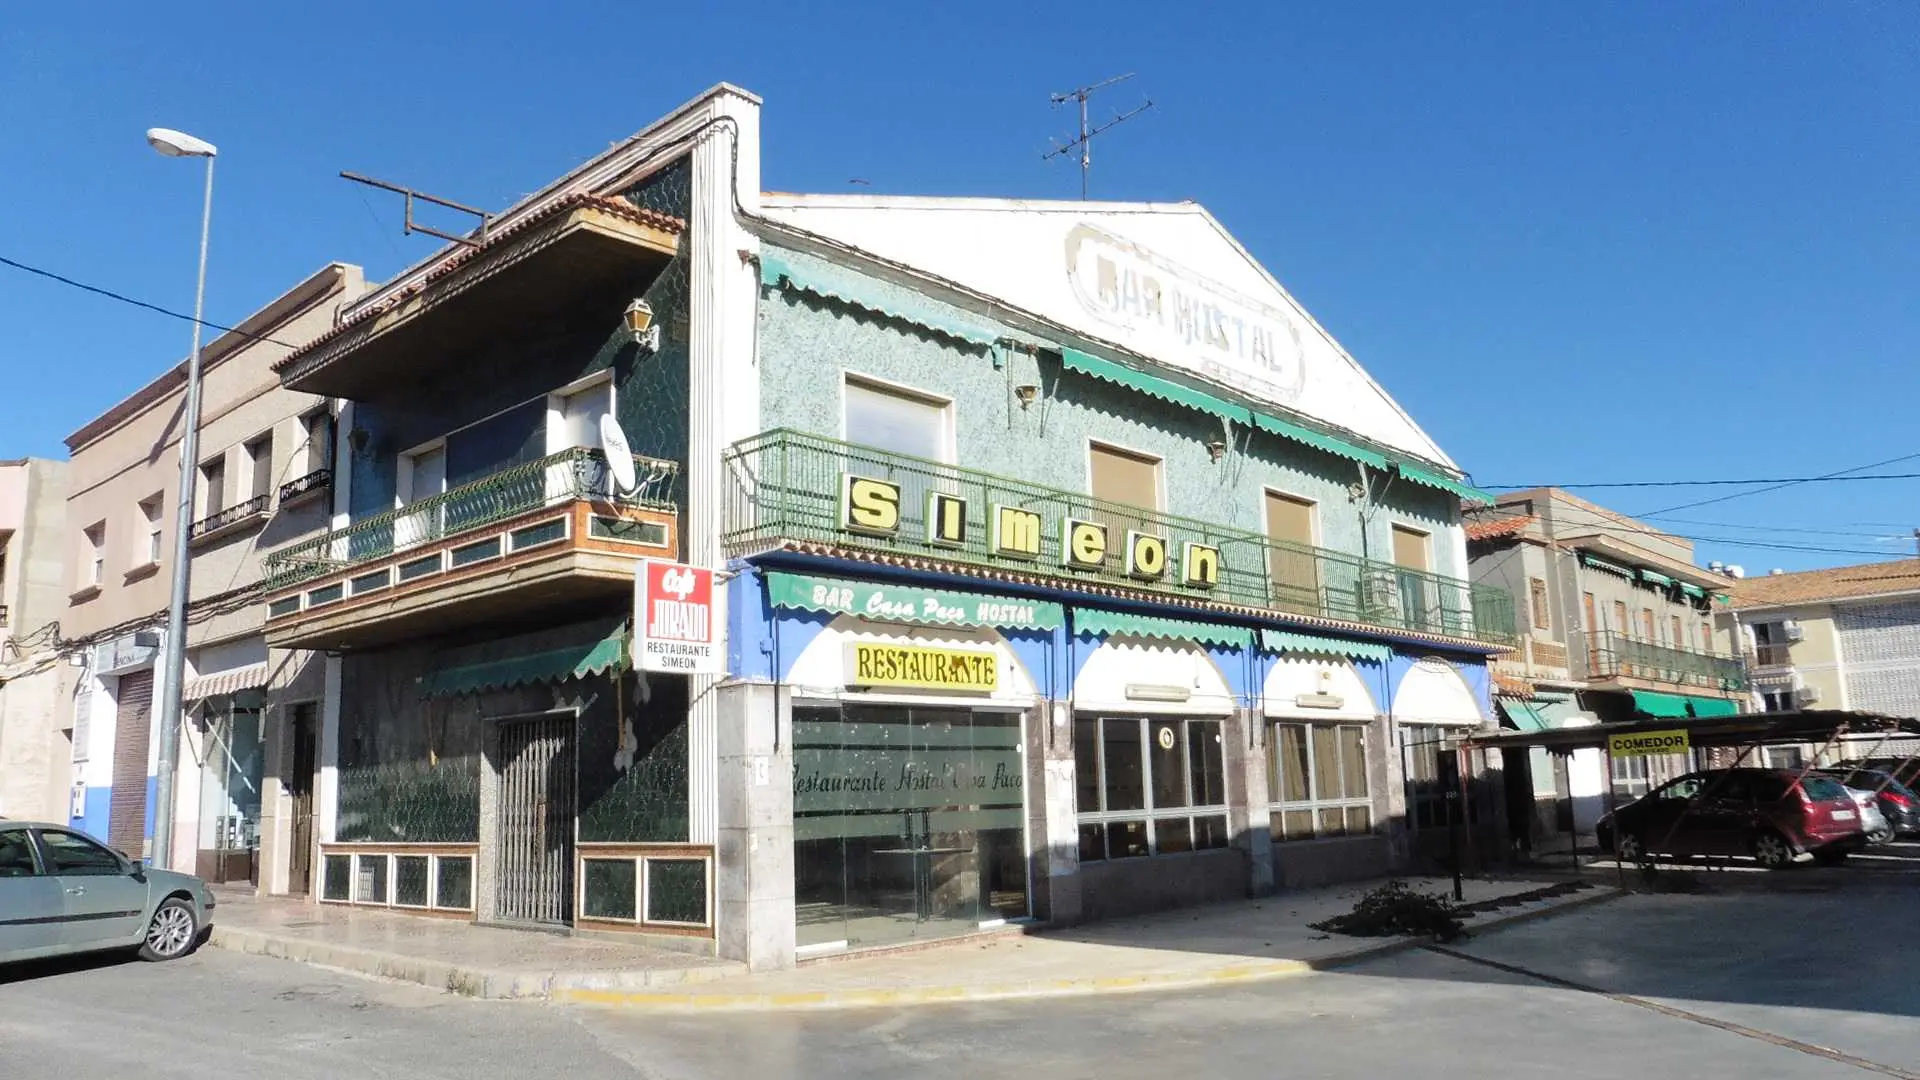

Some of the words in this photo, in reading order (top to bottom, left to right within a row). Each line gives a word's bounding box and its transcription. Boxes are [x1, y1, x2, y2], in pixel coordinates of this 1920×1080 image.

[812, 585, 855, 610] BAR
[866, 591, 916, 617] Casa
[923, 598, 967, 621] Paco
[977, 602, 1035, 624] HOSTAL
[649, 599, 709, 641] JURADO
[647, 641, 711, 657] RESTAURANTE
[661, 656, 697, 670] SIMEON
[858, 647, 994, 686] RESTAURANTE
[1613, 735, 1685, 751] COMEDOR
